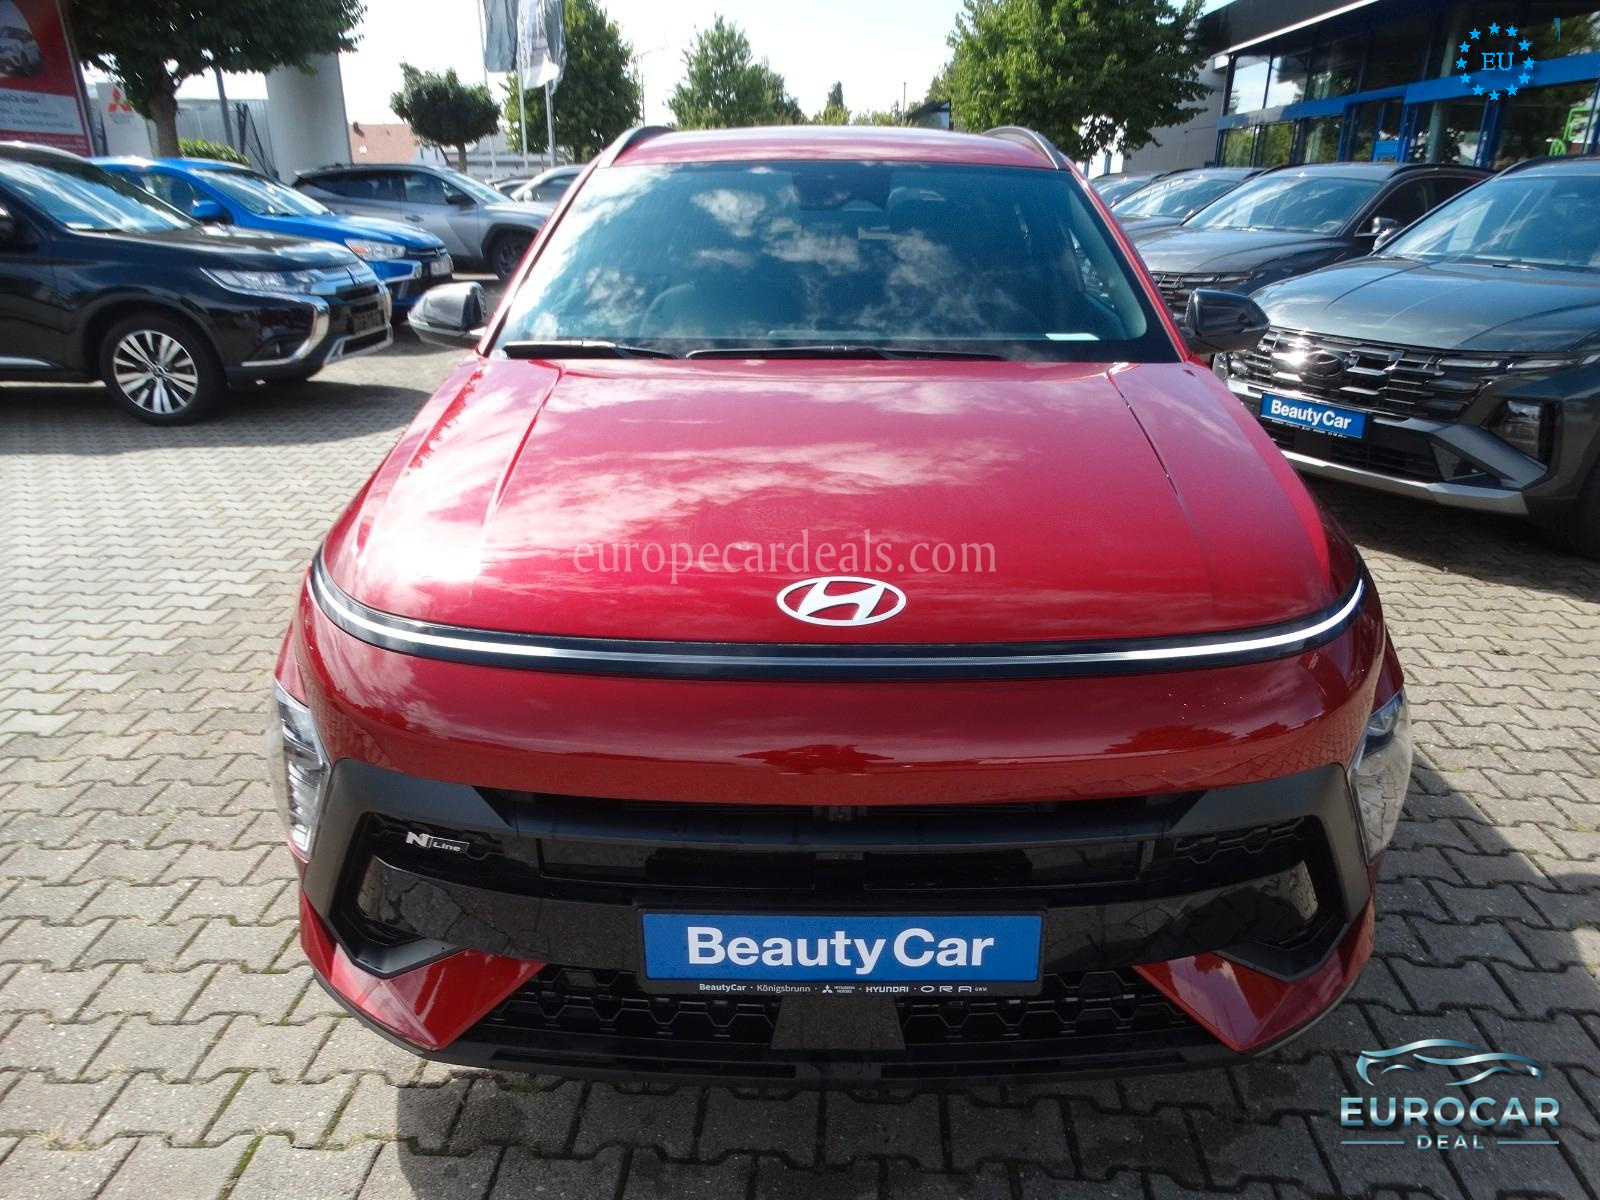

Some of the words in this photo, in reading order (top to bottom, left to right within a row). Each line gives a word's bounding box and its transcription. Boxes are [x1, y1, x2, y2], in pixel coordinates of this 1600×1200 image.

[406, 831, 429, 847] N
[699, 983, 747, 992] BeautyCar
[756, 984, 811, 993] Königsbrunn
[866, 985, 909, 993] HYUNDAI
